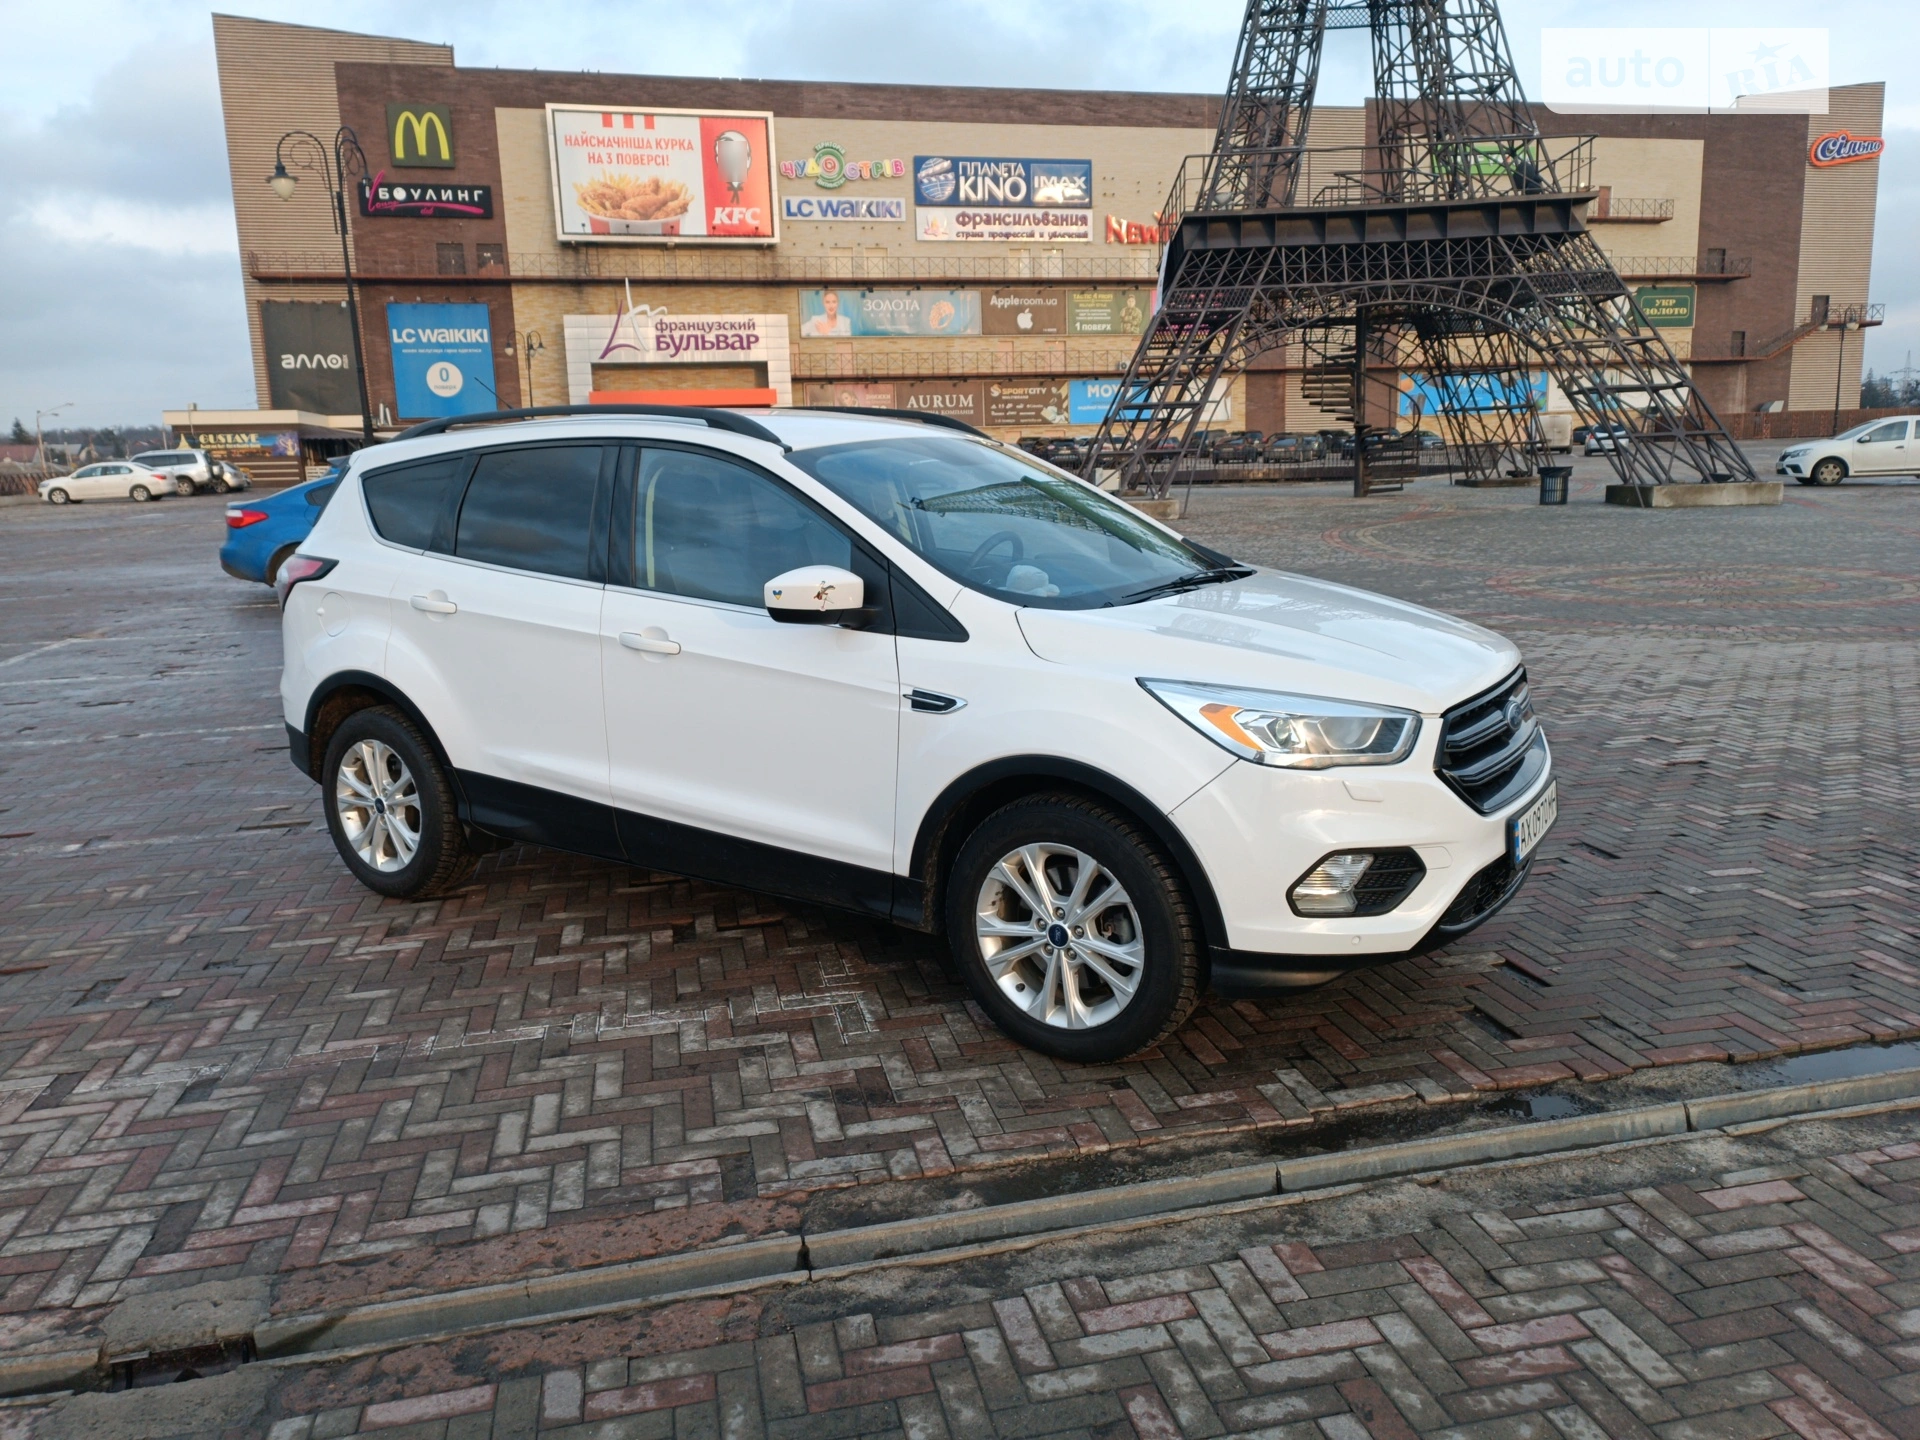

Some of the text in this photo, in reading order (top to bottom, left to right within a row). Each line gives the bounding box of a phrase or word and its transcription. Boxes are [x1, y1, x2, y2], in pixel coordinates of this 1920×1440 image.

[564, 131, 694, 151] НАЙСМАЧНІША КУРКА
[1817, 134, 1882, 161] Сільпо
[588, 154, 670, 166] НА 3 ПОВЕРСІ!
[959, 176, 1027, 202] KINO
[1034, 175, 1087, 189] IMAX
[378, 187, 483, 201] БОУЛИНГ
[785, 199, 814, 217] LC
[712, 207, 761, 225] KFC
[955, 211, 1089, 229] Франсильвания
[863, 299, 920, 311] ЗОЛОТА
[990, 294, 1058, 309] Appleroom.ua
[1655, 299, 1676, 307] УКР
[1643, 307, 1687, 315] ЗОЛОТО
[655, 318, 756, 333] французский
[1082, 323, 1112, 331] ПОВЕРХ
[392, 328, 416, 344] LC
[1002, 387, 1047, 395] SPORTCITY
[906, 394, 974, 409] AURUM
